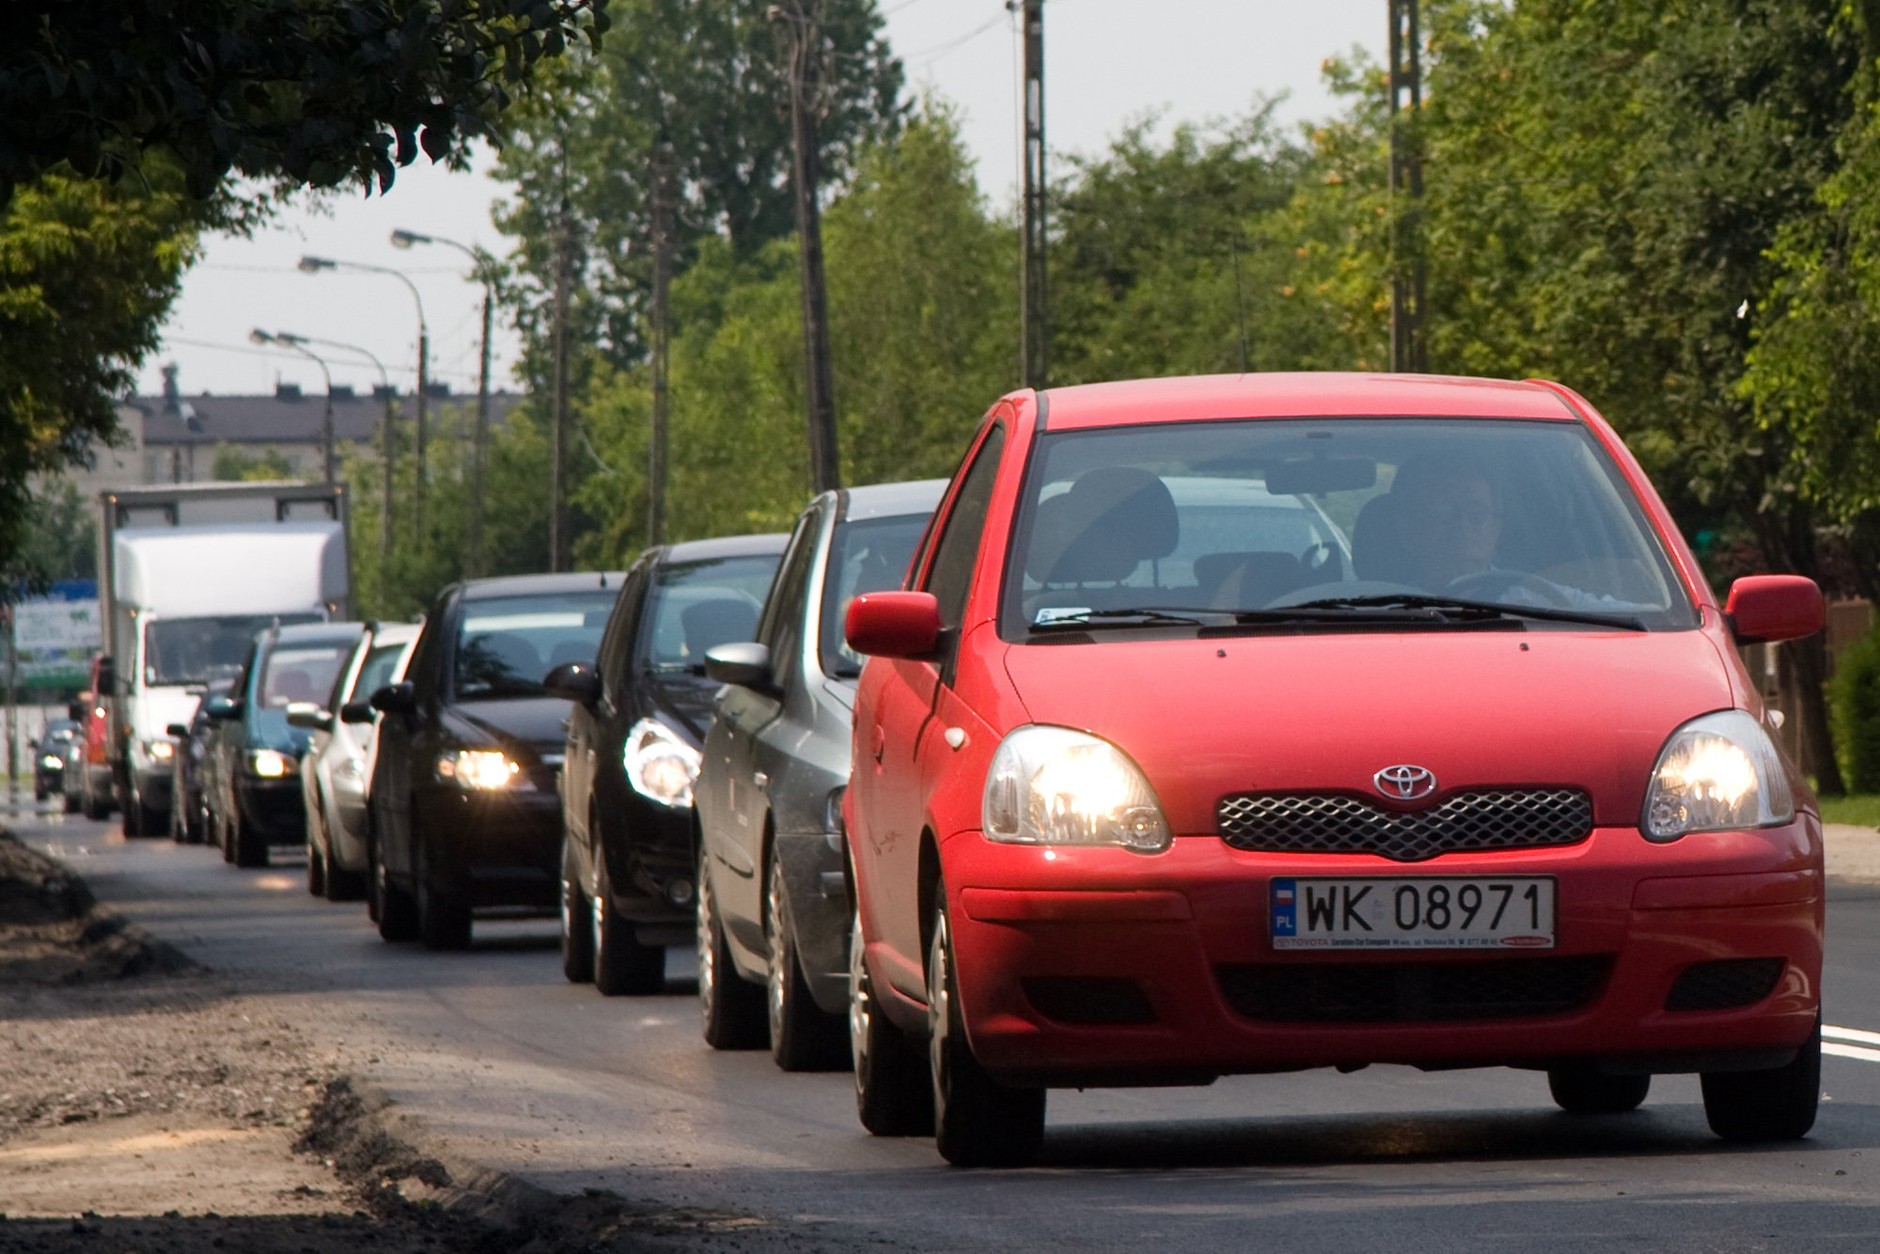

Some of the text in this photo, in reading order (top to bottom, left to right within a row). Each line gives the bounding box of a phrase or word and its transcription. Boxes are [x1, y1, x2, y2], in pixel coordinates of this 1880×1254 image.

[1305, 884, 1539, 932] WK 08971
[1276, 915, 1293, 929] PL
[1291, 938, 1329, 946] TOYOTA
